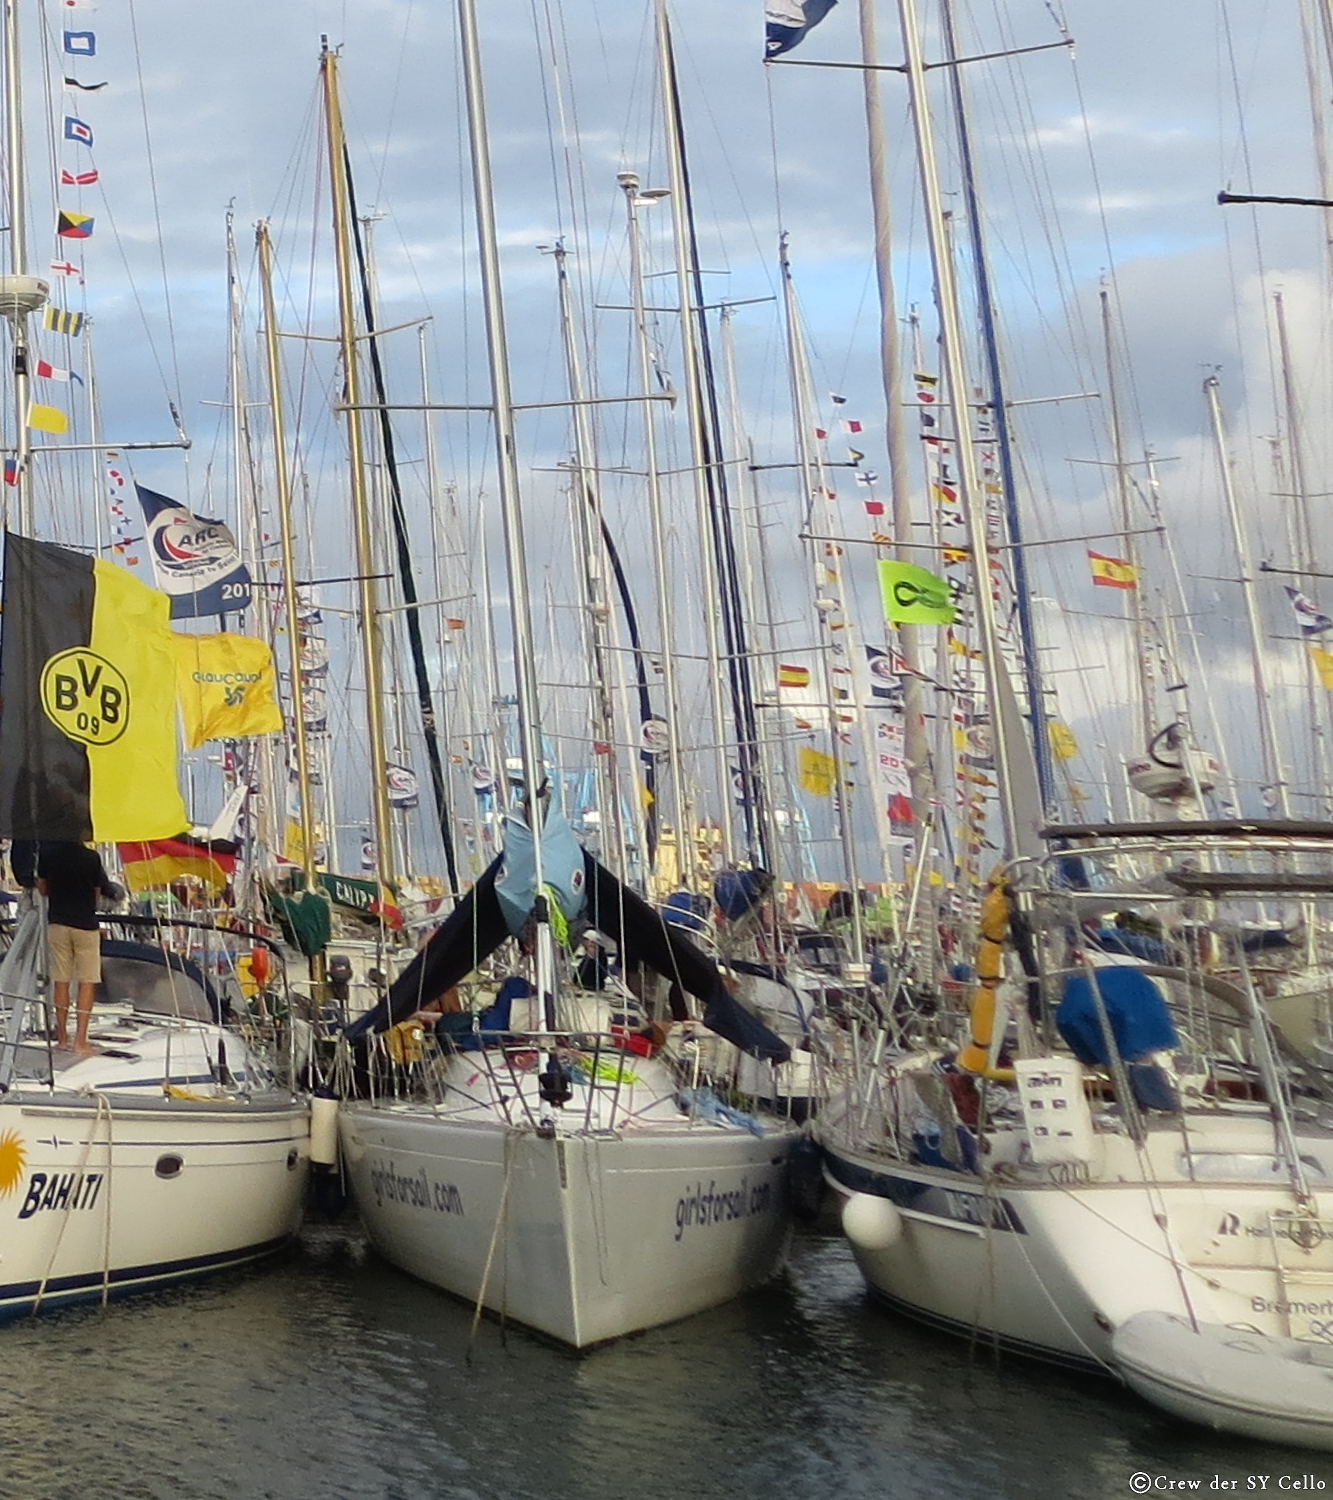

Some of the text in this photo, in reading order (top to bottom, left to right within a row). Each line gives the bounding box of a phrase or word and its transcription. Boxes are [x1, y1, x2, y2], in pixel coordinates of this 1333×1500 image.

[178, 527, 220, 548] ARC
[171, 566, 205, 578] Canaria
[221, 582, 251, 600] 201
[55, 658, 122, 724] BVB
[76, 712, 100, 735] 09
[371, 1159, 464, 1216] girlsforsail.com
[675, 1177, 771, 1241] girlsforsail.com
